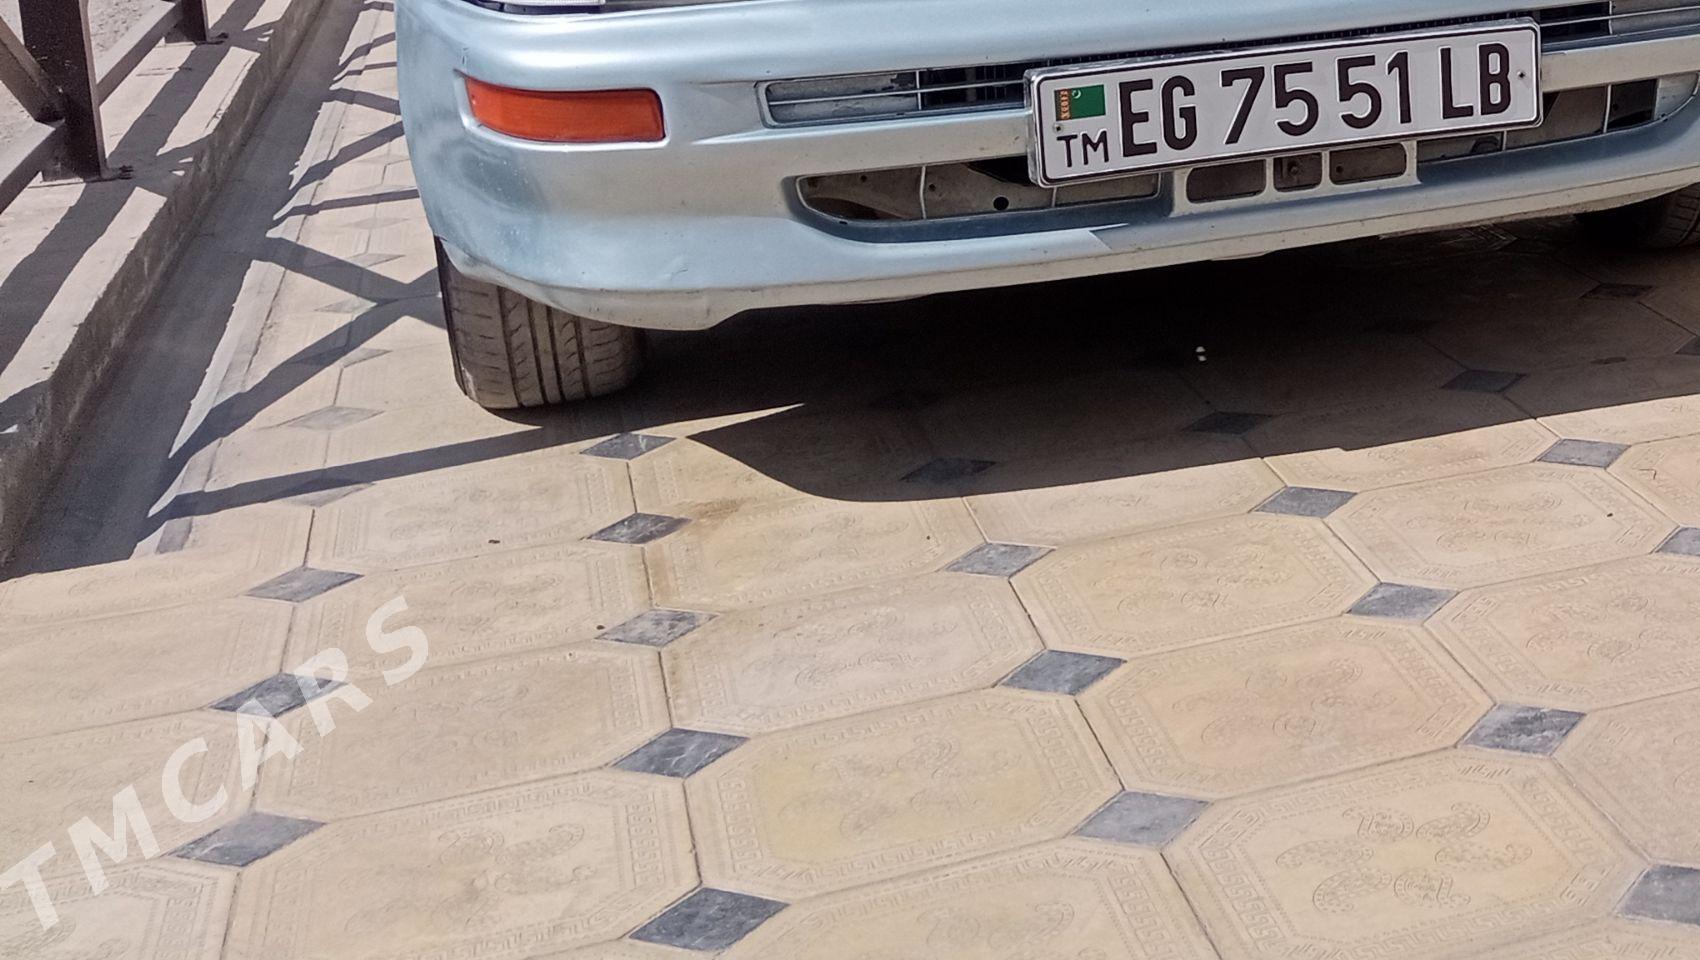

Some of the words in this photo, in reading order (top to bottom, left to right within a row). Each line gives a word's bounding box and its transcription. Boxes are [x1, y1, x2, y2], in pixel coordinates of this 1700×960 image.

[1119, 75, 1198, 158] EG
[1439, 42, 1511, 120] LB
[1056, 129, 1110, 168] TM
